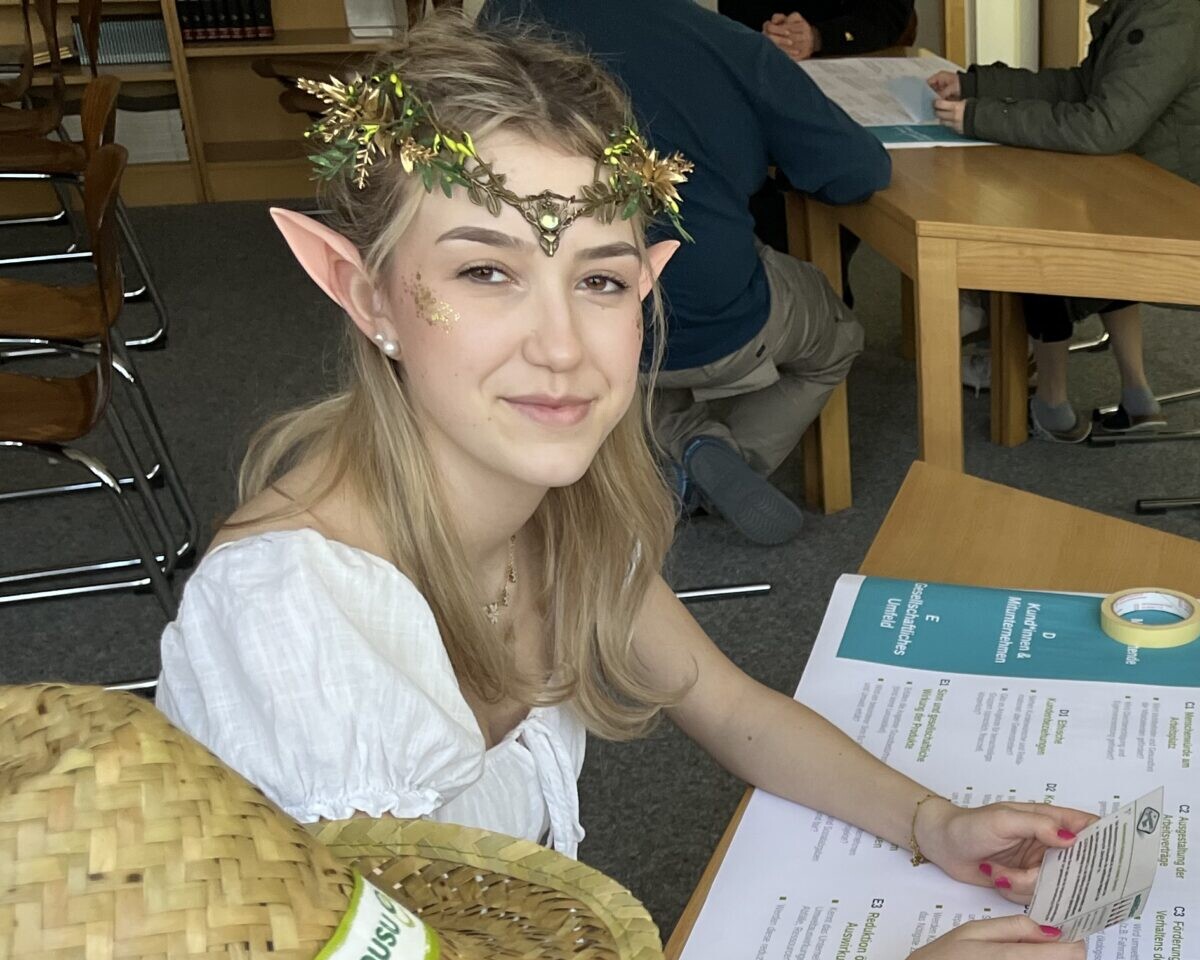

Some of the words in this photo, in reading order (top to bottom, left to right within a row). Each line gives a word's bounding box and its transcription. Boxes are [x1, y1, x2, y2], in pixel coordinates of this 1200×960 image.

[880, 598, 902, 629] Umfeld
[894, 583, 926, 656] Gesellschaftliches
[926, 614, 940, 622] E
[995, 597, 1021, 663] Mitunternehmen
[1046, 783, 1057, 792] D2
[1179, 805, 1190, 814] C2
[1158, 815, 1174, 867] Arbeitsverträge
[1174, 817, 1189, 865] Ausgestaltung
[1176, 867, 1186, 879] der
[871, 899, 885, 908] E3
[1173, 906, 1185, 917] C3
[858, 912, 881, 953] Reduktion
[1154, 911, 1168, 951] Verhaltens
